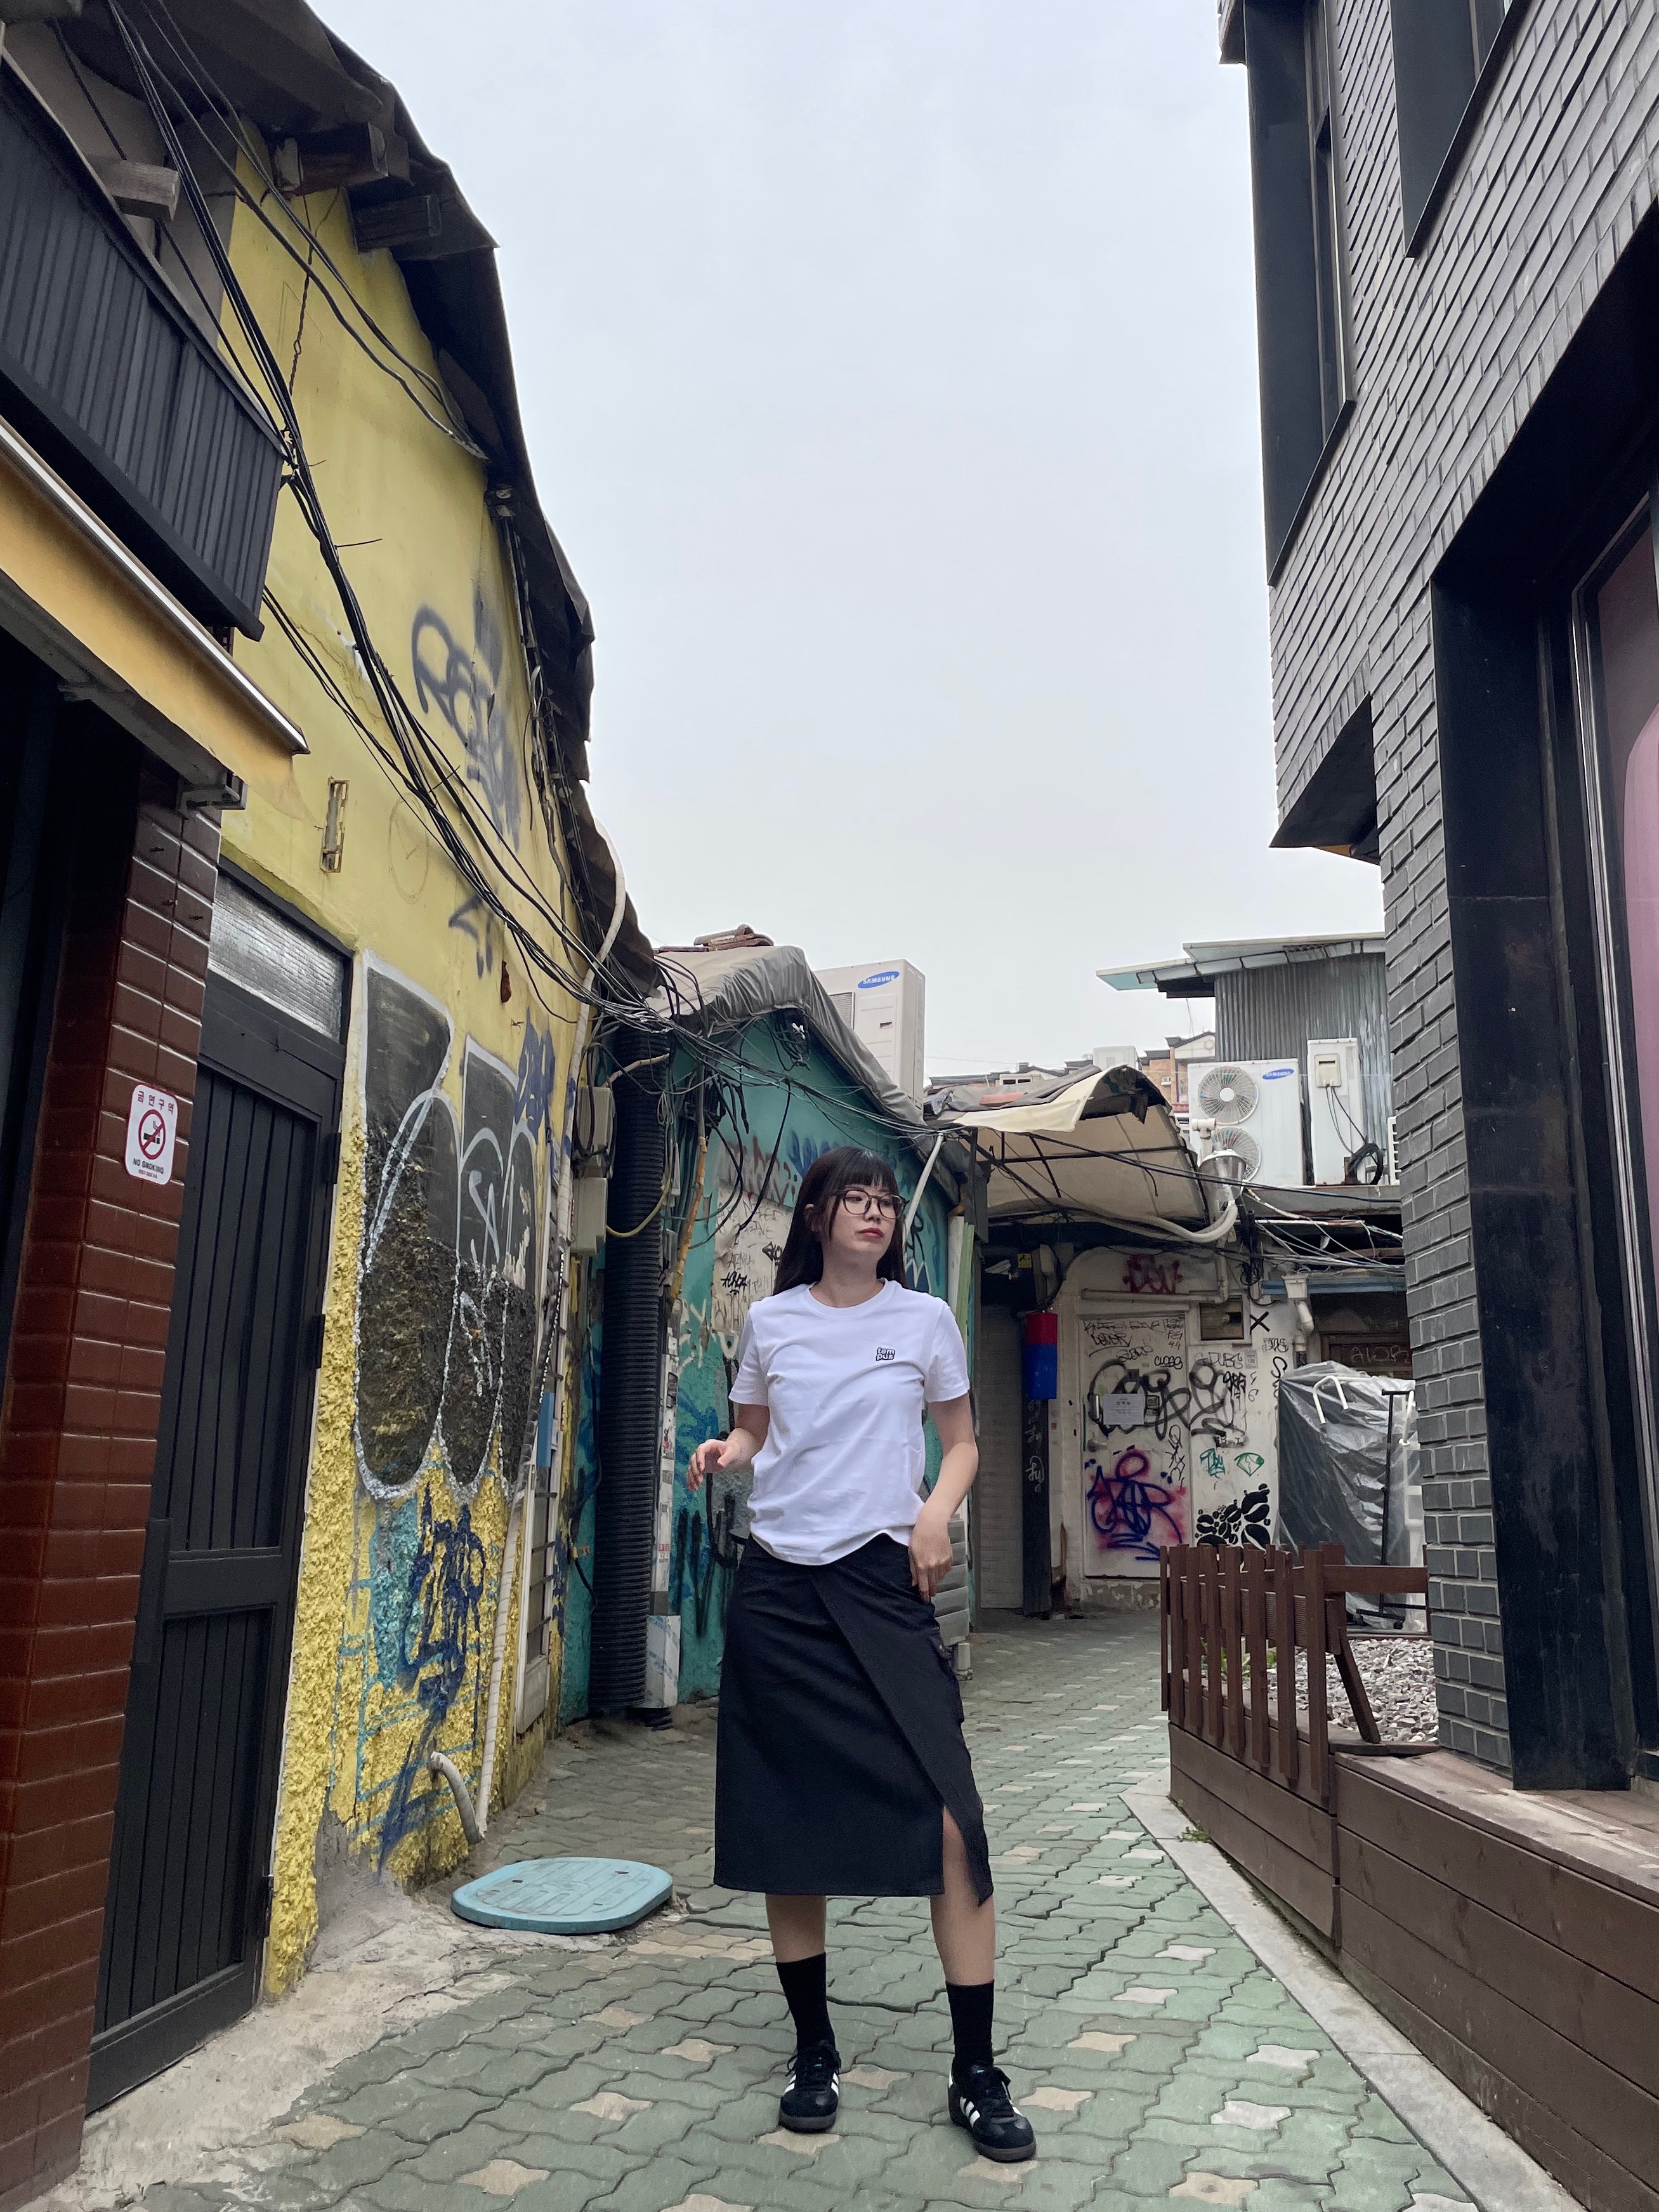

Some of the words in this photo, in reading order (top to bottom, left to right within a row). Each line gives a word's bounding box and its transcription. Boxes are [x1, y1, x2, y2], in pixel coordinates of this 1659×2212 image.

[863, 975, 895, 985] SAMSUNG
[133, 1157, 141, 1166] NO
[142, 1161, 164, 1175] SMOKING
